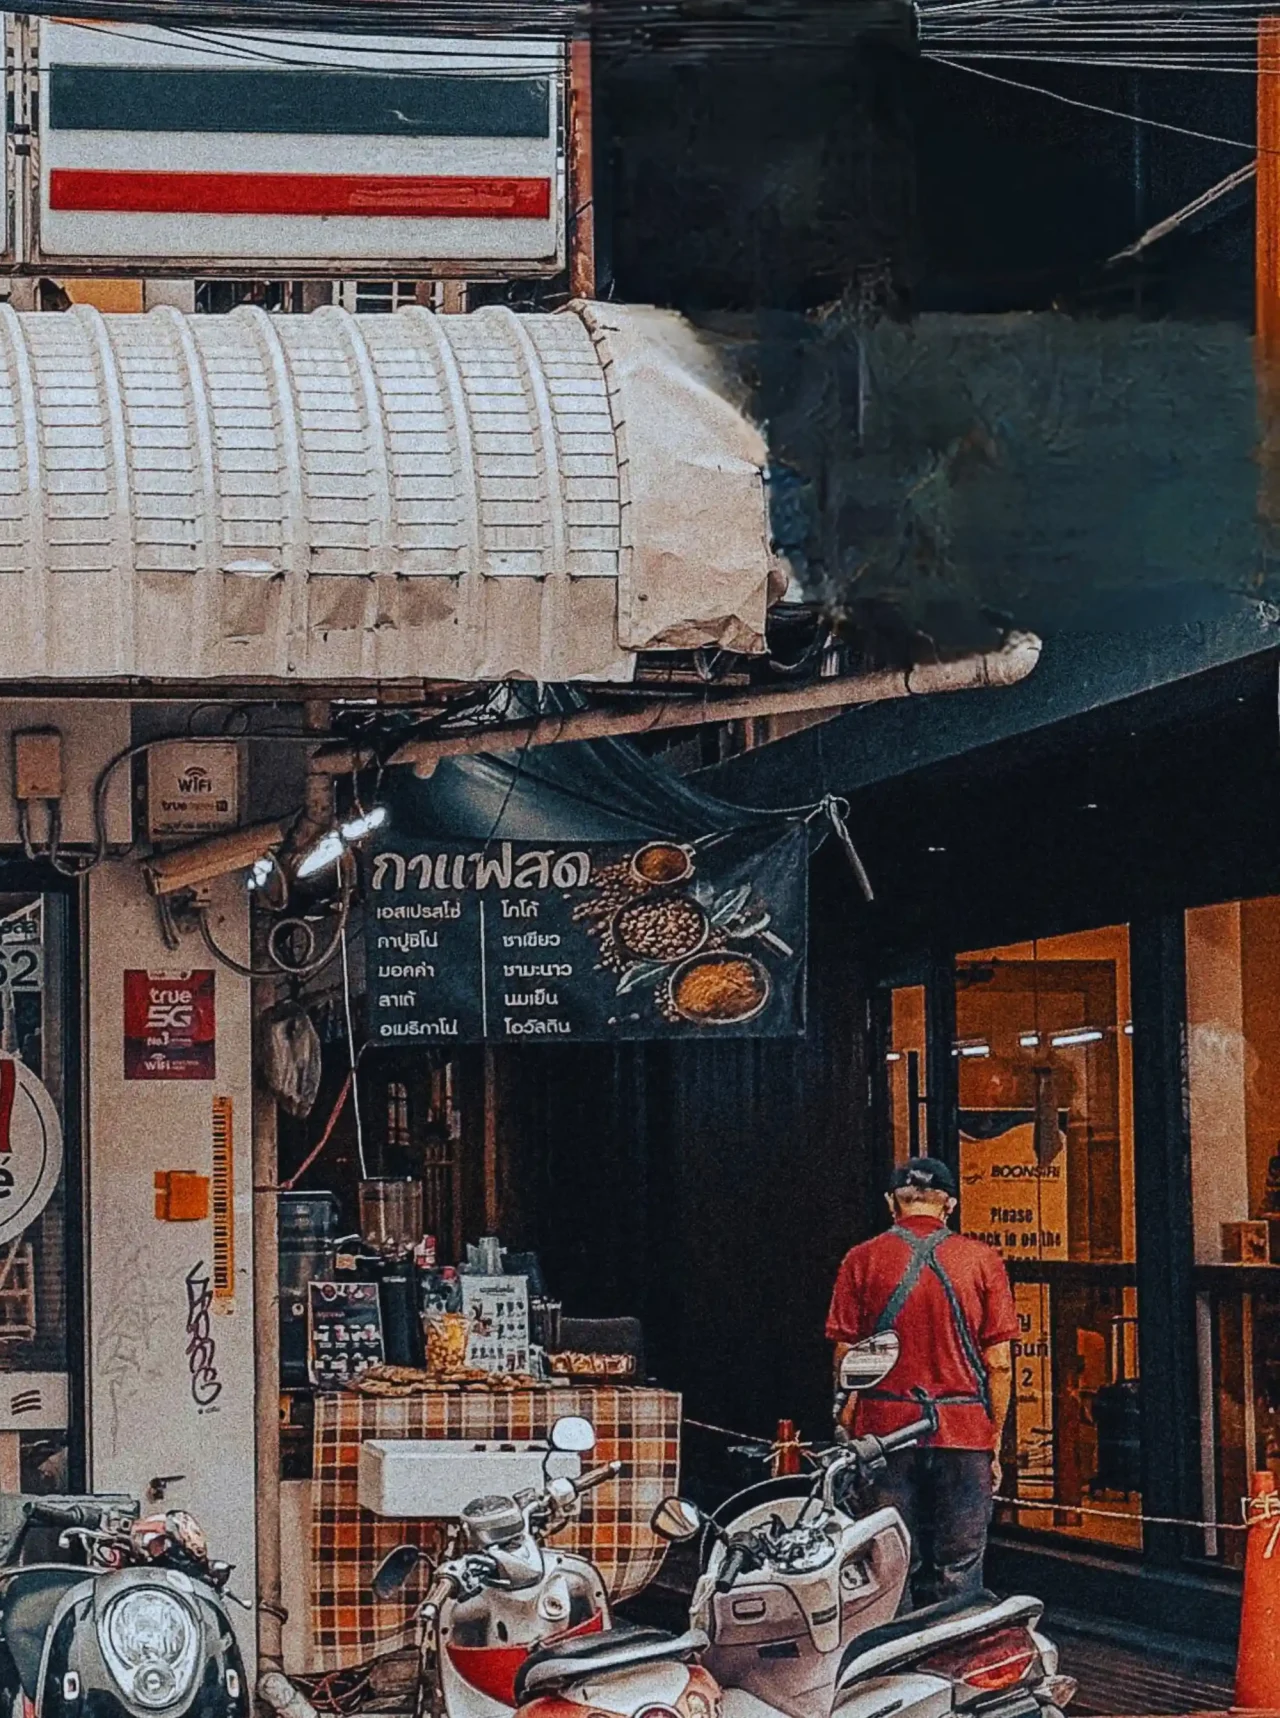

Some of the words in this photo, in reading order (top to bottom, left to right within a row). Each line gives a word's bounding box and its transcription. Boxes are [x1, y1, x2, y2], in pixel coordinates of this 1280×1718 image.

[371, 841, 591, 891] กาแฟสด
[500, 898, 541, 918] โกโก้
[502, 929, 562, 948] ชาเขียว
[377, 961, 436, 979] มอคค่า
[502, 962, 574, 978] ชามะนาว
[148, 987, 193, 1004] true
[378, 989, 418, 1008] ลาเต้
[503, 987, 560, 1007] นมเย็น
[144, 1004, 194, 1028] 5G
[503, 1016, 573, 1036] โอวัลติน
[989, 1206, 1034, 1224] Please
[1005, 1229, 1017, 1247] in
[1021, 1231, 1038, 1248] on
